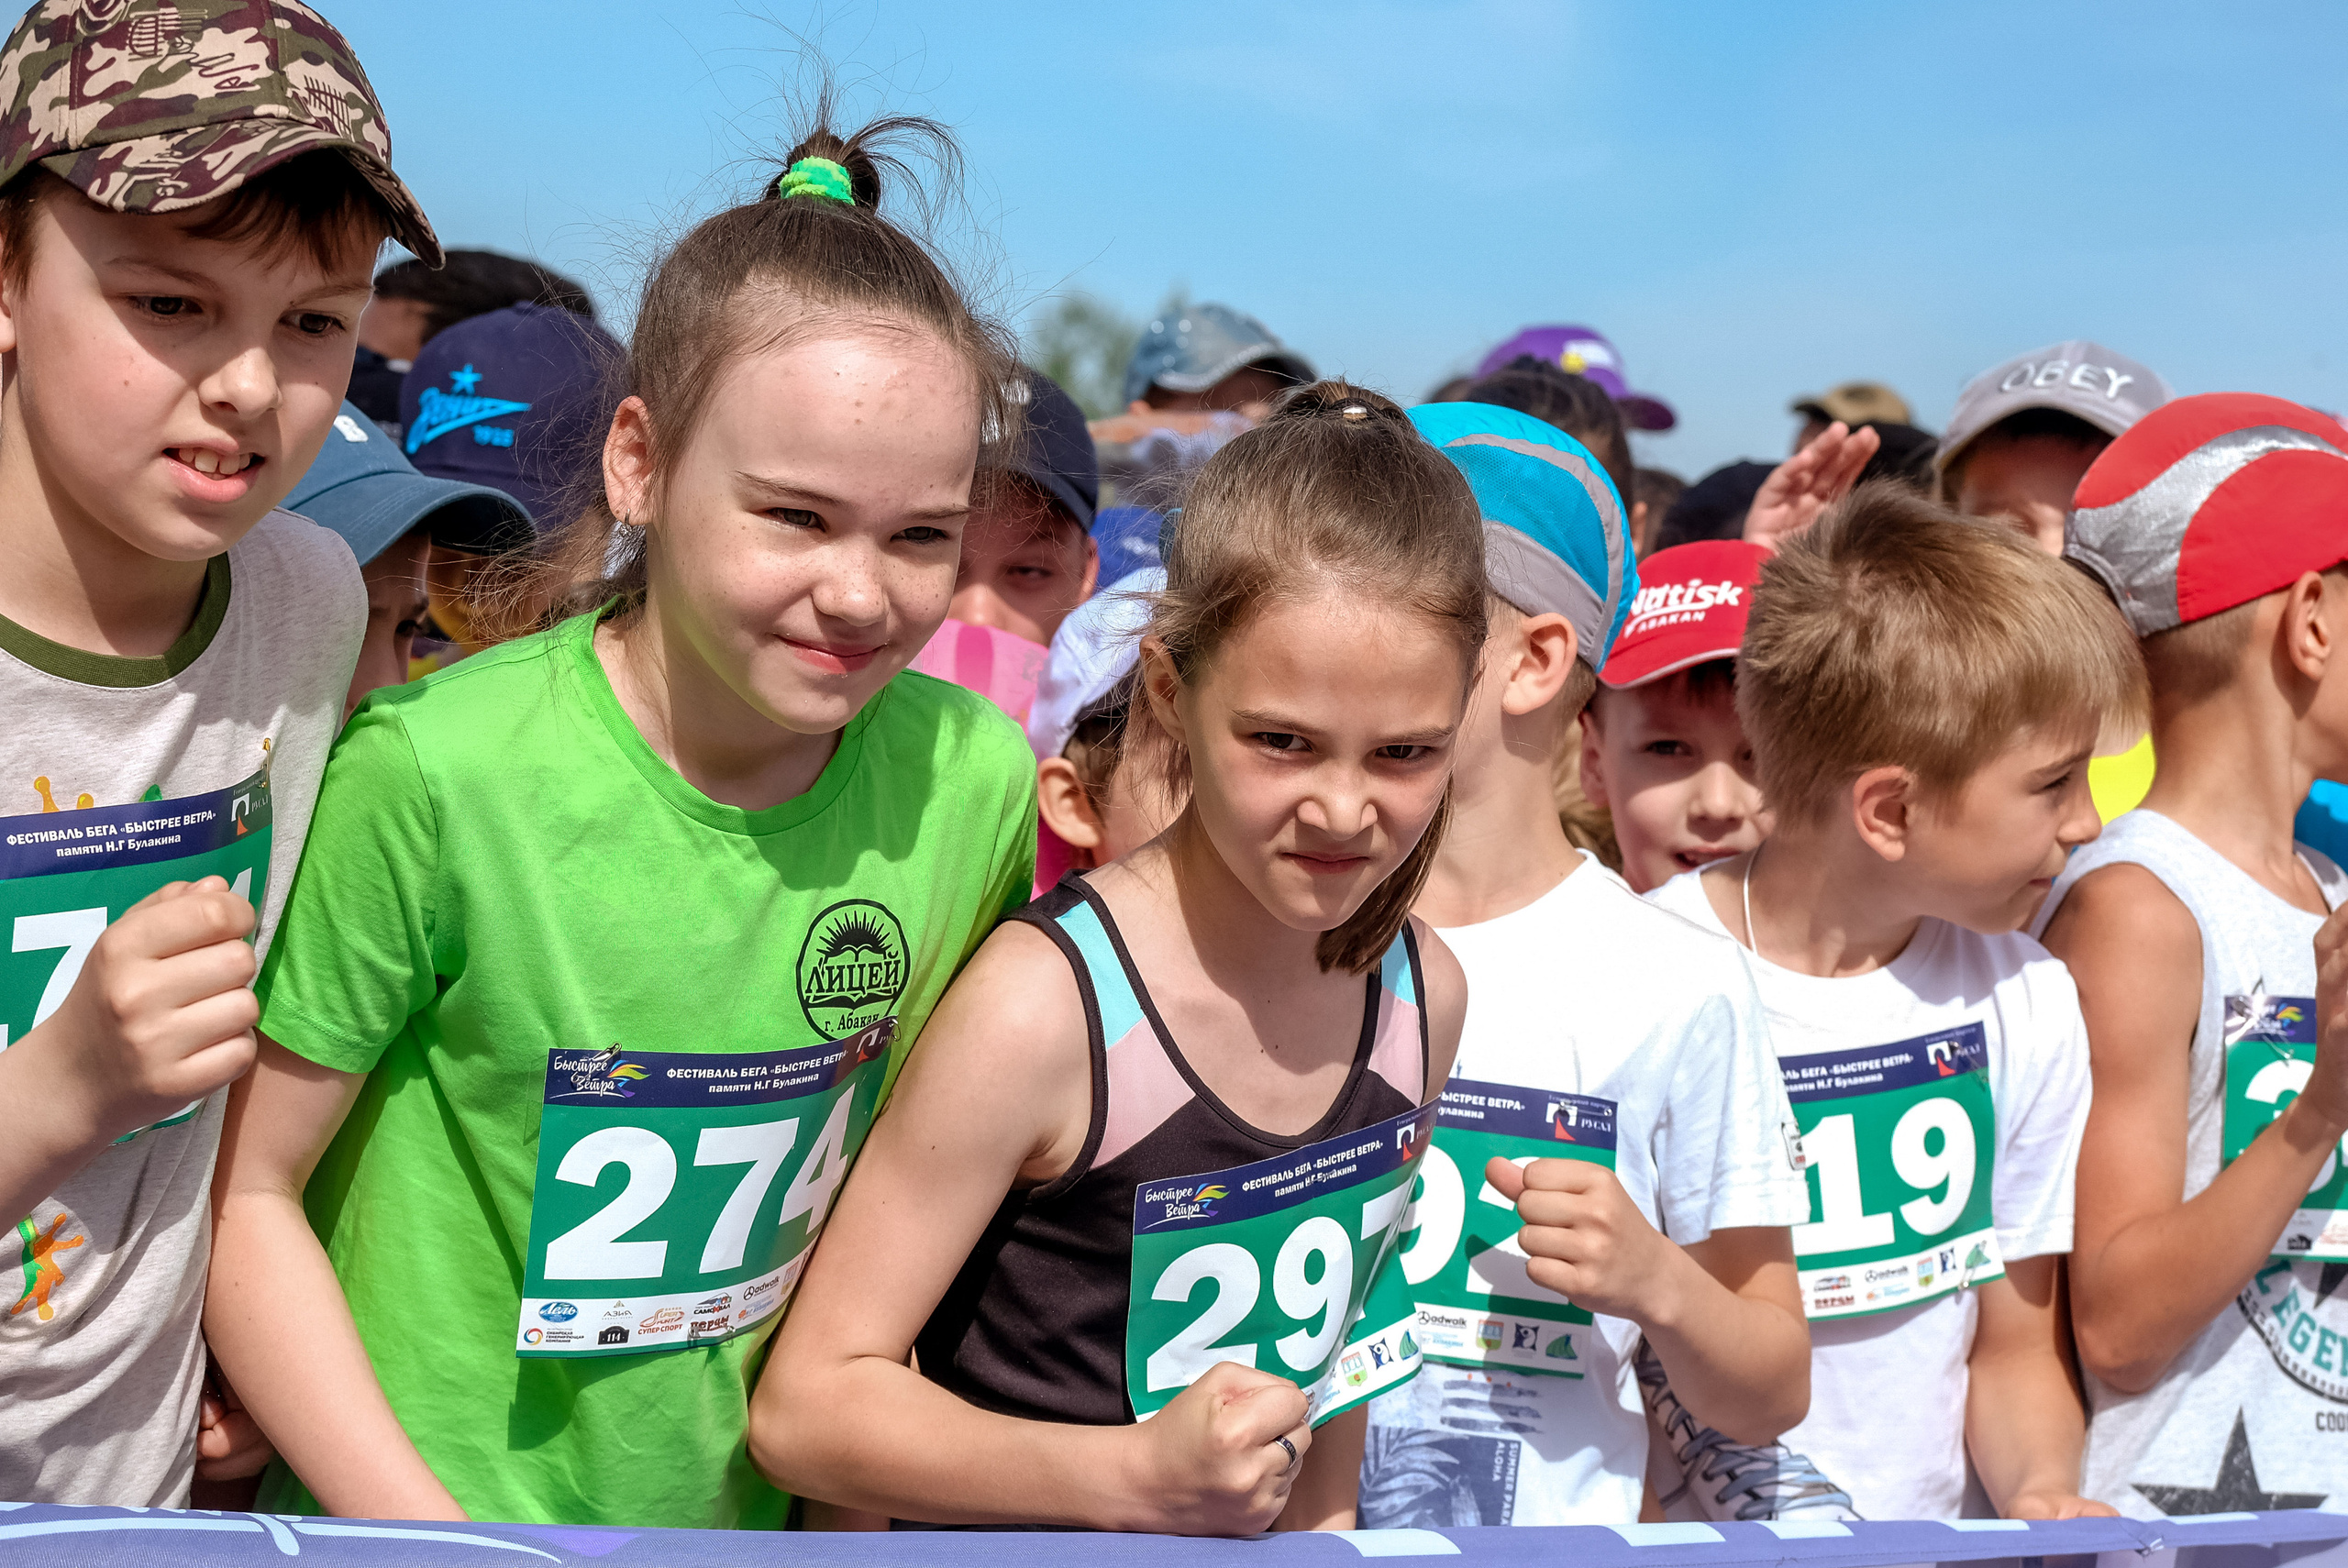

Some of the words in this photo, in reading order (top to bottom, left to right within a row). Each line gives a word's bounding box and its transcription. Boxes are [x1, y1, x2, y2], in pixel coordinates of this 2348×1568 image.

[2001, 359, 2133, 399] OBEY
[6, 828, 83, 845] ФЕСТИВАЛЬ
[86, 824, 117, 838] БЕГА
[120, 816, 182, 834] «БЫСТРЕЕ
[183, 810, 216, 827] ВЕТРА»
[56, 844, 104, 858] памяти
[105, 840, 126, 853] Н.Г
[127, 834, 182, 851] Булакина
[805, 951, 901, 995] ЛИЦЕЙ
[666, 1067, 737, 1078] ФЕСТИВАЛЬ
[740, 1066, 768, 1077] БЕГА
[770, 1057, 822, 1075] «БЫСТРЕЕ
[1800, 1065, 1828, 1079] БЕГА
[1830, 1057, 1882, 1075] «БЫСТРЕЕ
[708, 1083, 751, 1093] памяти
[754, 1079, 770, 1090] Н.Г
[772, 1073, 819, 1088] Булакина
[1834, 1073, 1884, 1088] Булакина
[1441, 1091, 1486, 1106] ЫСТРЕЕ
[1487, 1097, 1525, 1110] ВЕТРА»
[1242, 1169, 1294, 1192] ФЕСТИВАЛЬ
[1295, 1162, 1312, 1177] БЕГА
[1312, 1150, 1357, 1169] «БЫСТРЕЕ
[1357, 1140, 1383, 1158] ВЕТРА»
[544, 1082, 857, 1279] 274
[1274, 1181, 1305, 1198] памяти
[1145, 1187, 1193, 1204] Быстрее
[1165, 1203, 1201, 1220] Ветра
[1146, 1177, 1412, 1393] 297
[637, 1327, 659, 1335] СУПЕР
[660, 1324, 683, 1332] СПОРТ
[1430, 1314, 1468, 1326] adwalk
